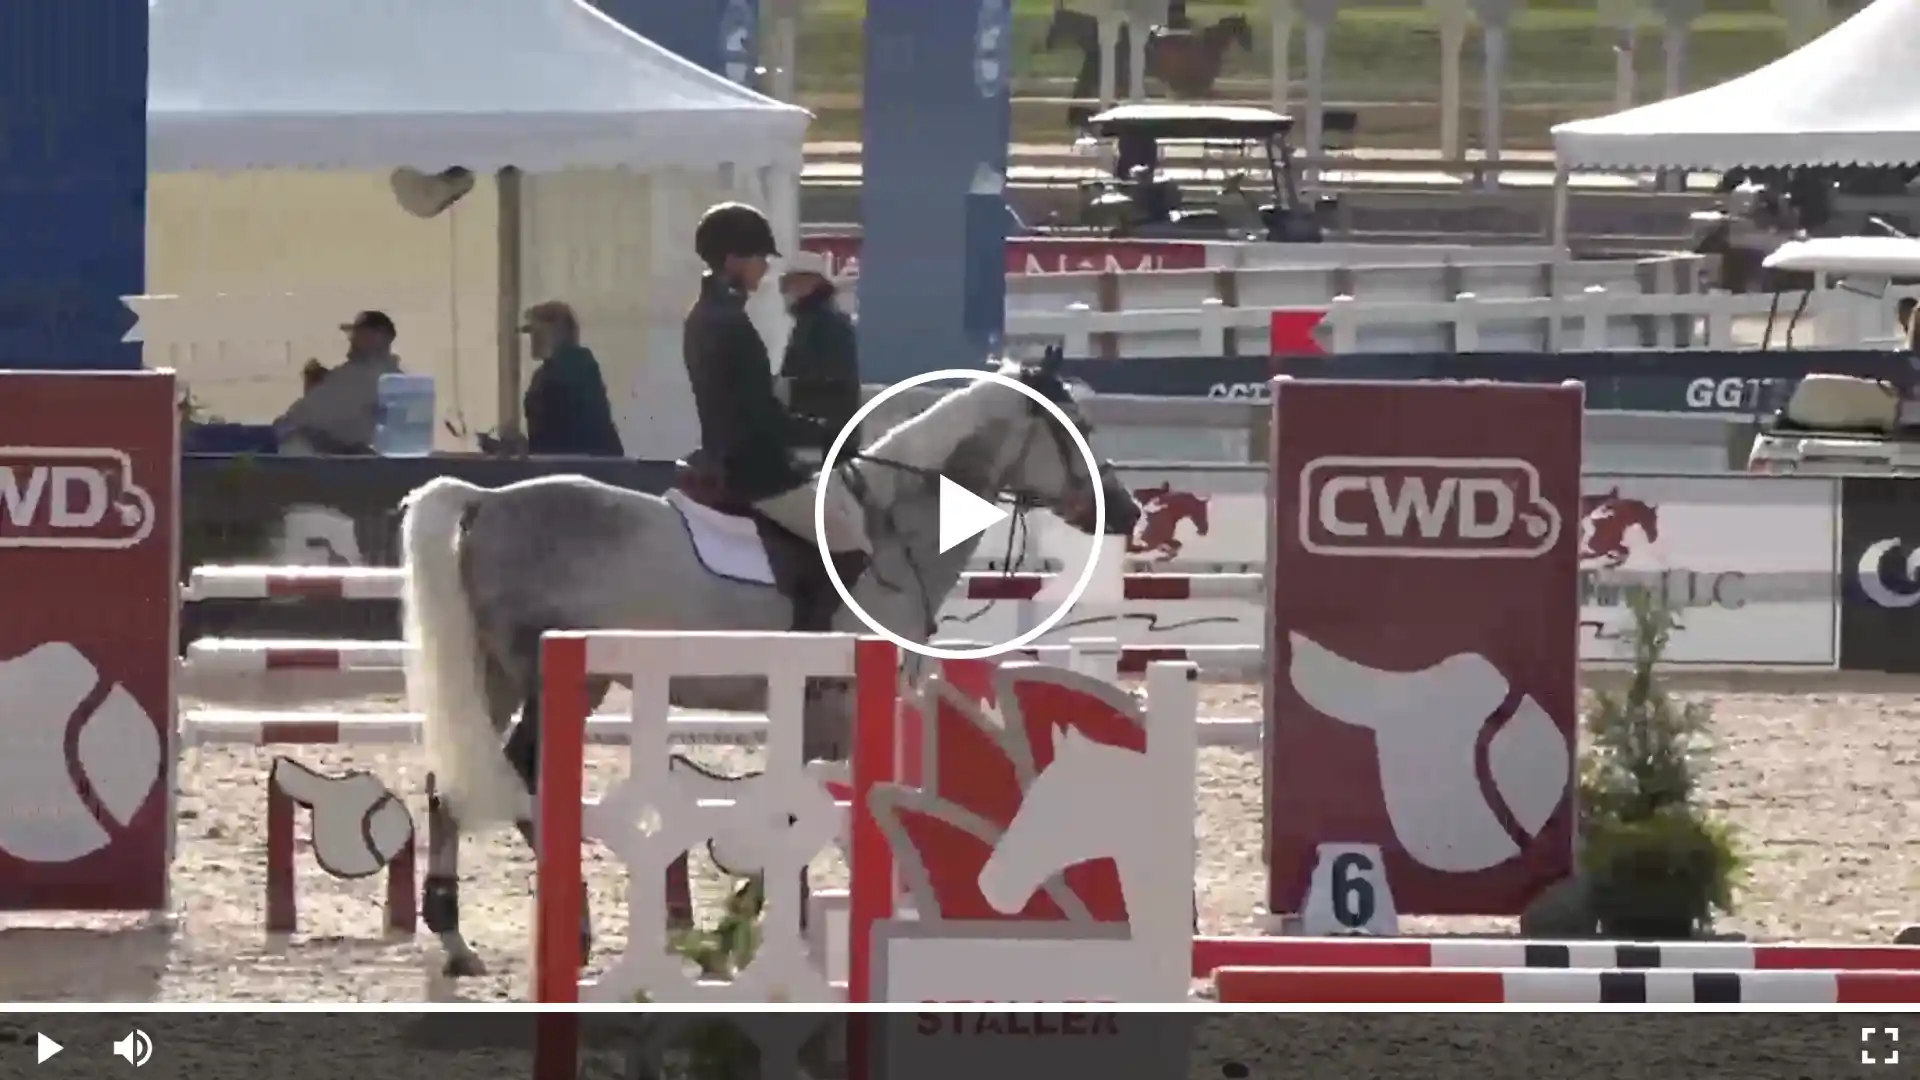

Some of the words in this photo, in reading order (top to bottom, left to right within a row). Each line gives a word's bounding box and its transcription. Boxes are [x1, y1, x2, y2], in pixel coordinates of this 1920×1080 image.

[0, 466, 107, 527] WD
[1319, 476, 1514, 538] CWD
[1332, 853, 1374, 927] 6
[917, 999, 1119, 1036] STALLER
